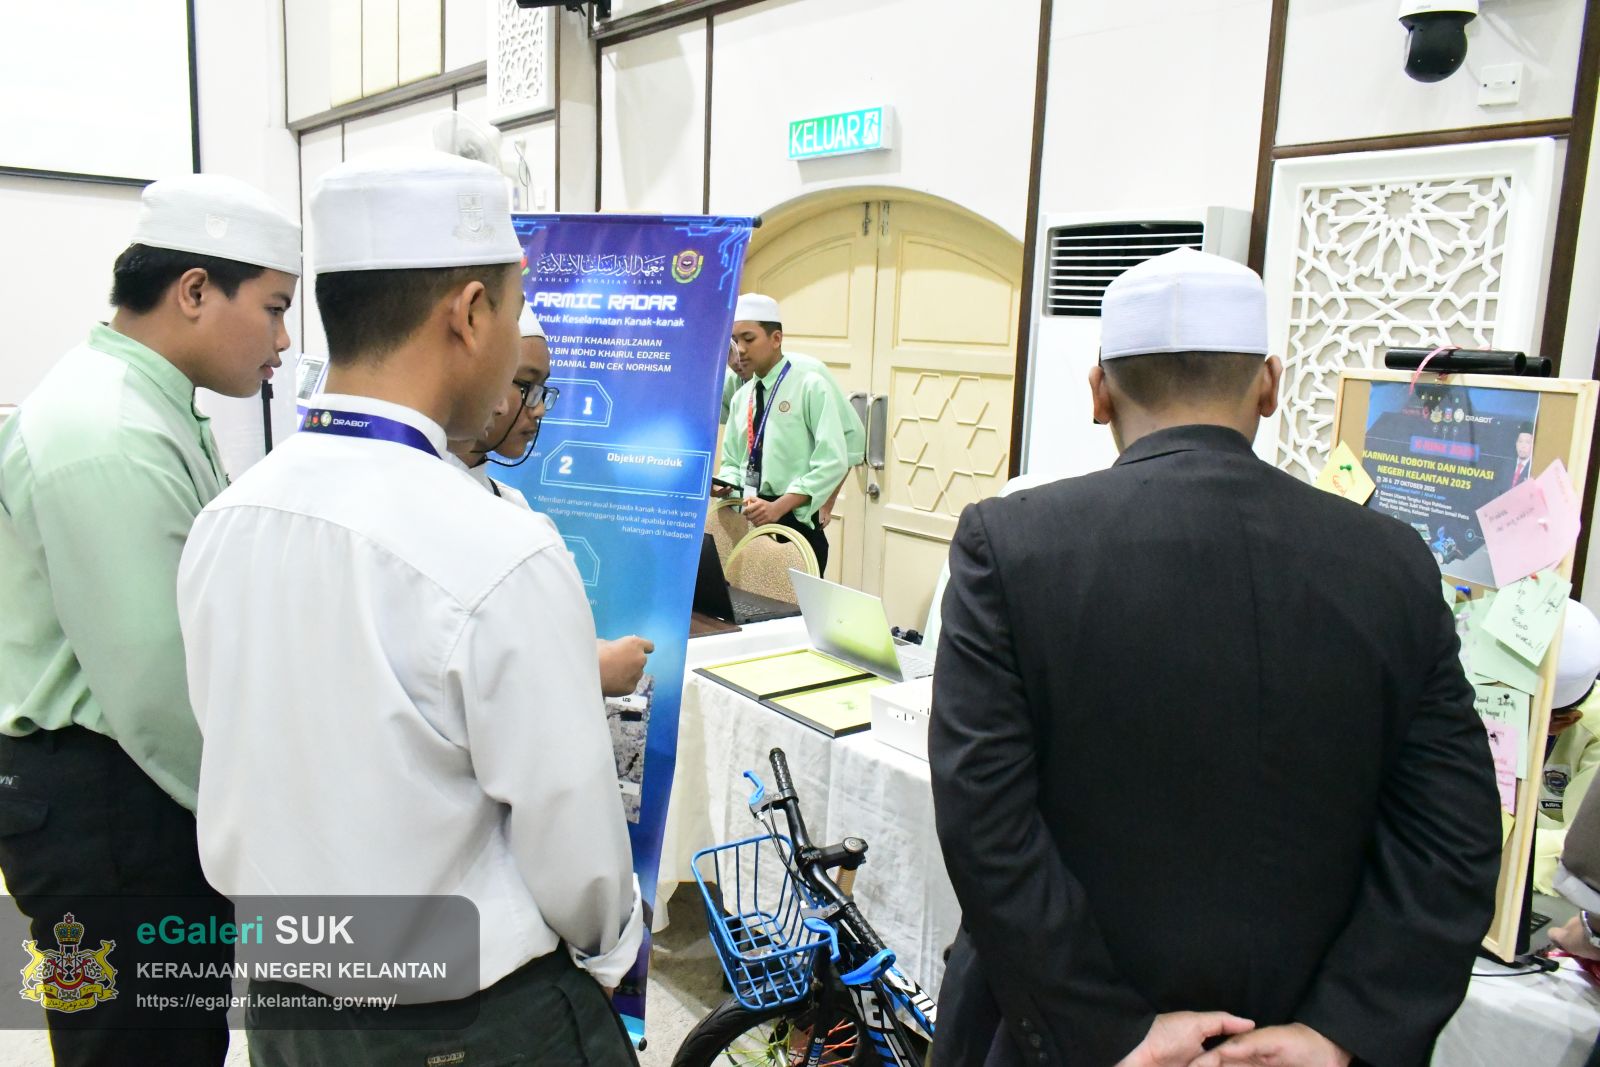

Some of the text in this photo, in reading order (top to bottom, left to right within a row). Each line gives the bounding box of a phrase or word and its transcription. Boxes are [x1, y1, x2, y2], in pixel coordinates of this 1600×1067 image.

[791, 114, 859, 155] KELUAR
[608, 294, 678, 311] RADAR
[563, 314, 622, 326] Keselamatan
[624, 316, 685, 327] Kanak-kanak
[562, 335, 583, 344] BINTI
[584, 336, 662, 347] KHAMARULZAMAN
[555, 347, 569, 355] BIN
[571, 348, 596, 357] MOHD
[598, 349, 635, 359] KHAIRUL
[637, 351, 671, 360] EDZREE
[557, 359, 587, 369] DANIAL
[590, 361, 605, 370] BIN
[607, 362, 623, 371] CEK
[626, 363, 672, 372] NORHISAM
[582, 396, 593, 415] 1
[558, 455, 573, 474] 2
[607, 452, 683, 468] Objektif Produk
[1362, 449, 1400, 464] KARNIVAL
[1400, 455, 1436, 470] ROBOTIK
[1437, 462, 1457, 473] DAN
[1457, 465, 1494, 480] INOVASI
[1377, 464, 1472, 490] NEGERI KELANTAN 2025
[1400, 480, 1424, 490] OKTOBER
[616, 513, 640, 522] basikal
[666, 519, 696, 529] terdapat
[680, 510, 698, 519] yang
[622, 525, 654, 536] halangan
[662, 530, 693, 540] hadapan
